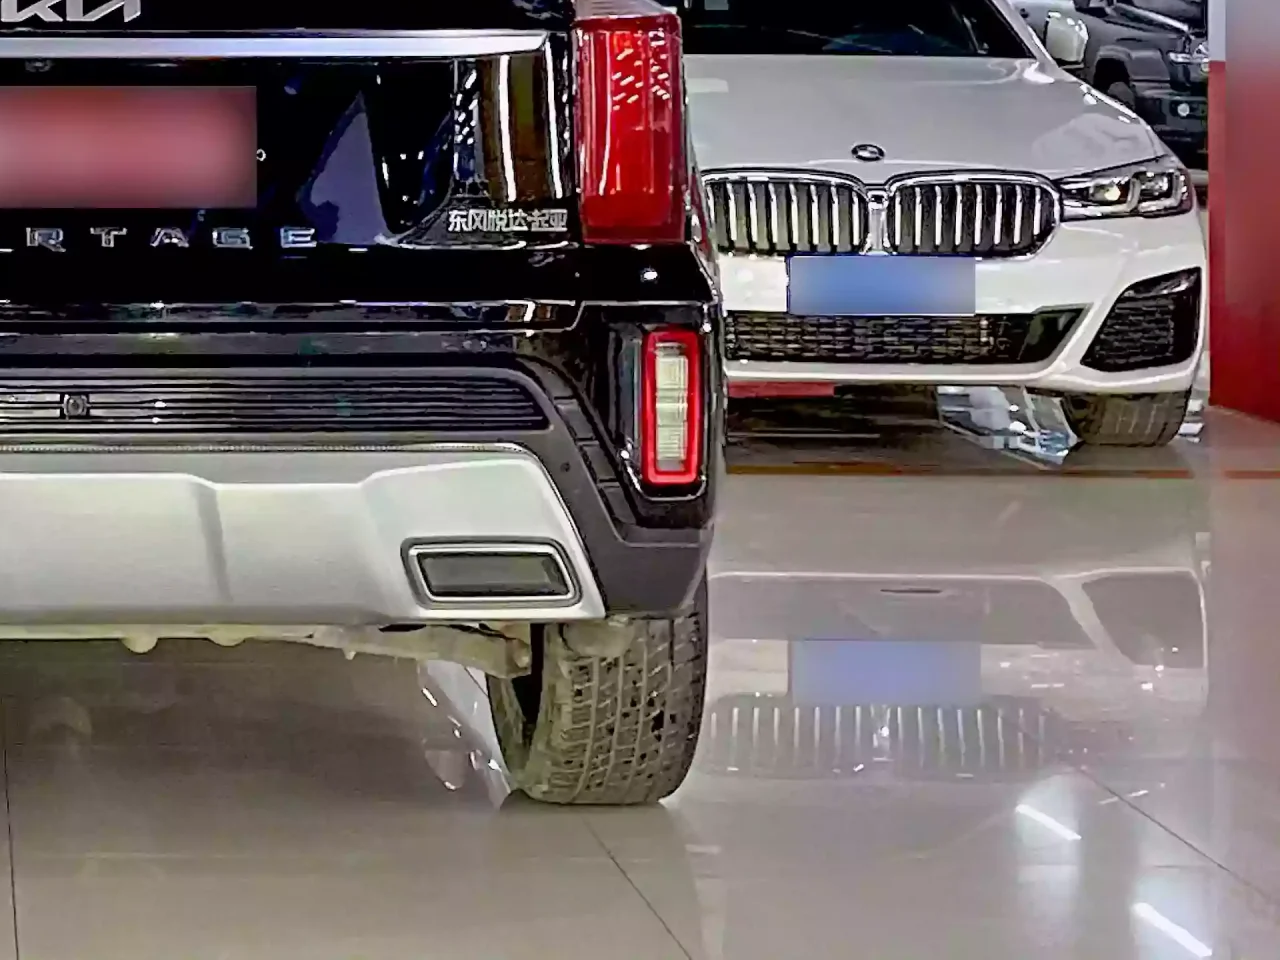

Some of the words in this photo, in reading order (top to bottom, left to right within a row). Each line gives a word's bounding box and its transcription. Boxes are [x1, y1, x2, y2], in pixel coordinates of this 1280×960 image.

[447, 208, 568, 232] 东风悦达起亚
